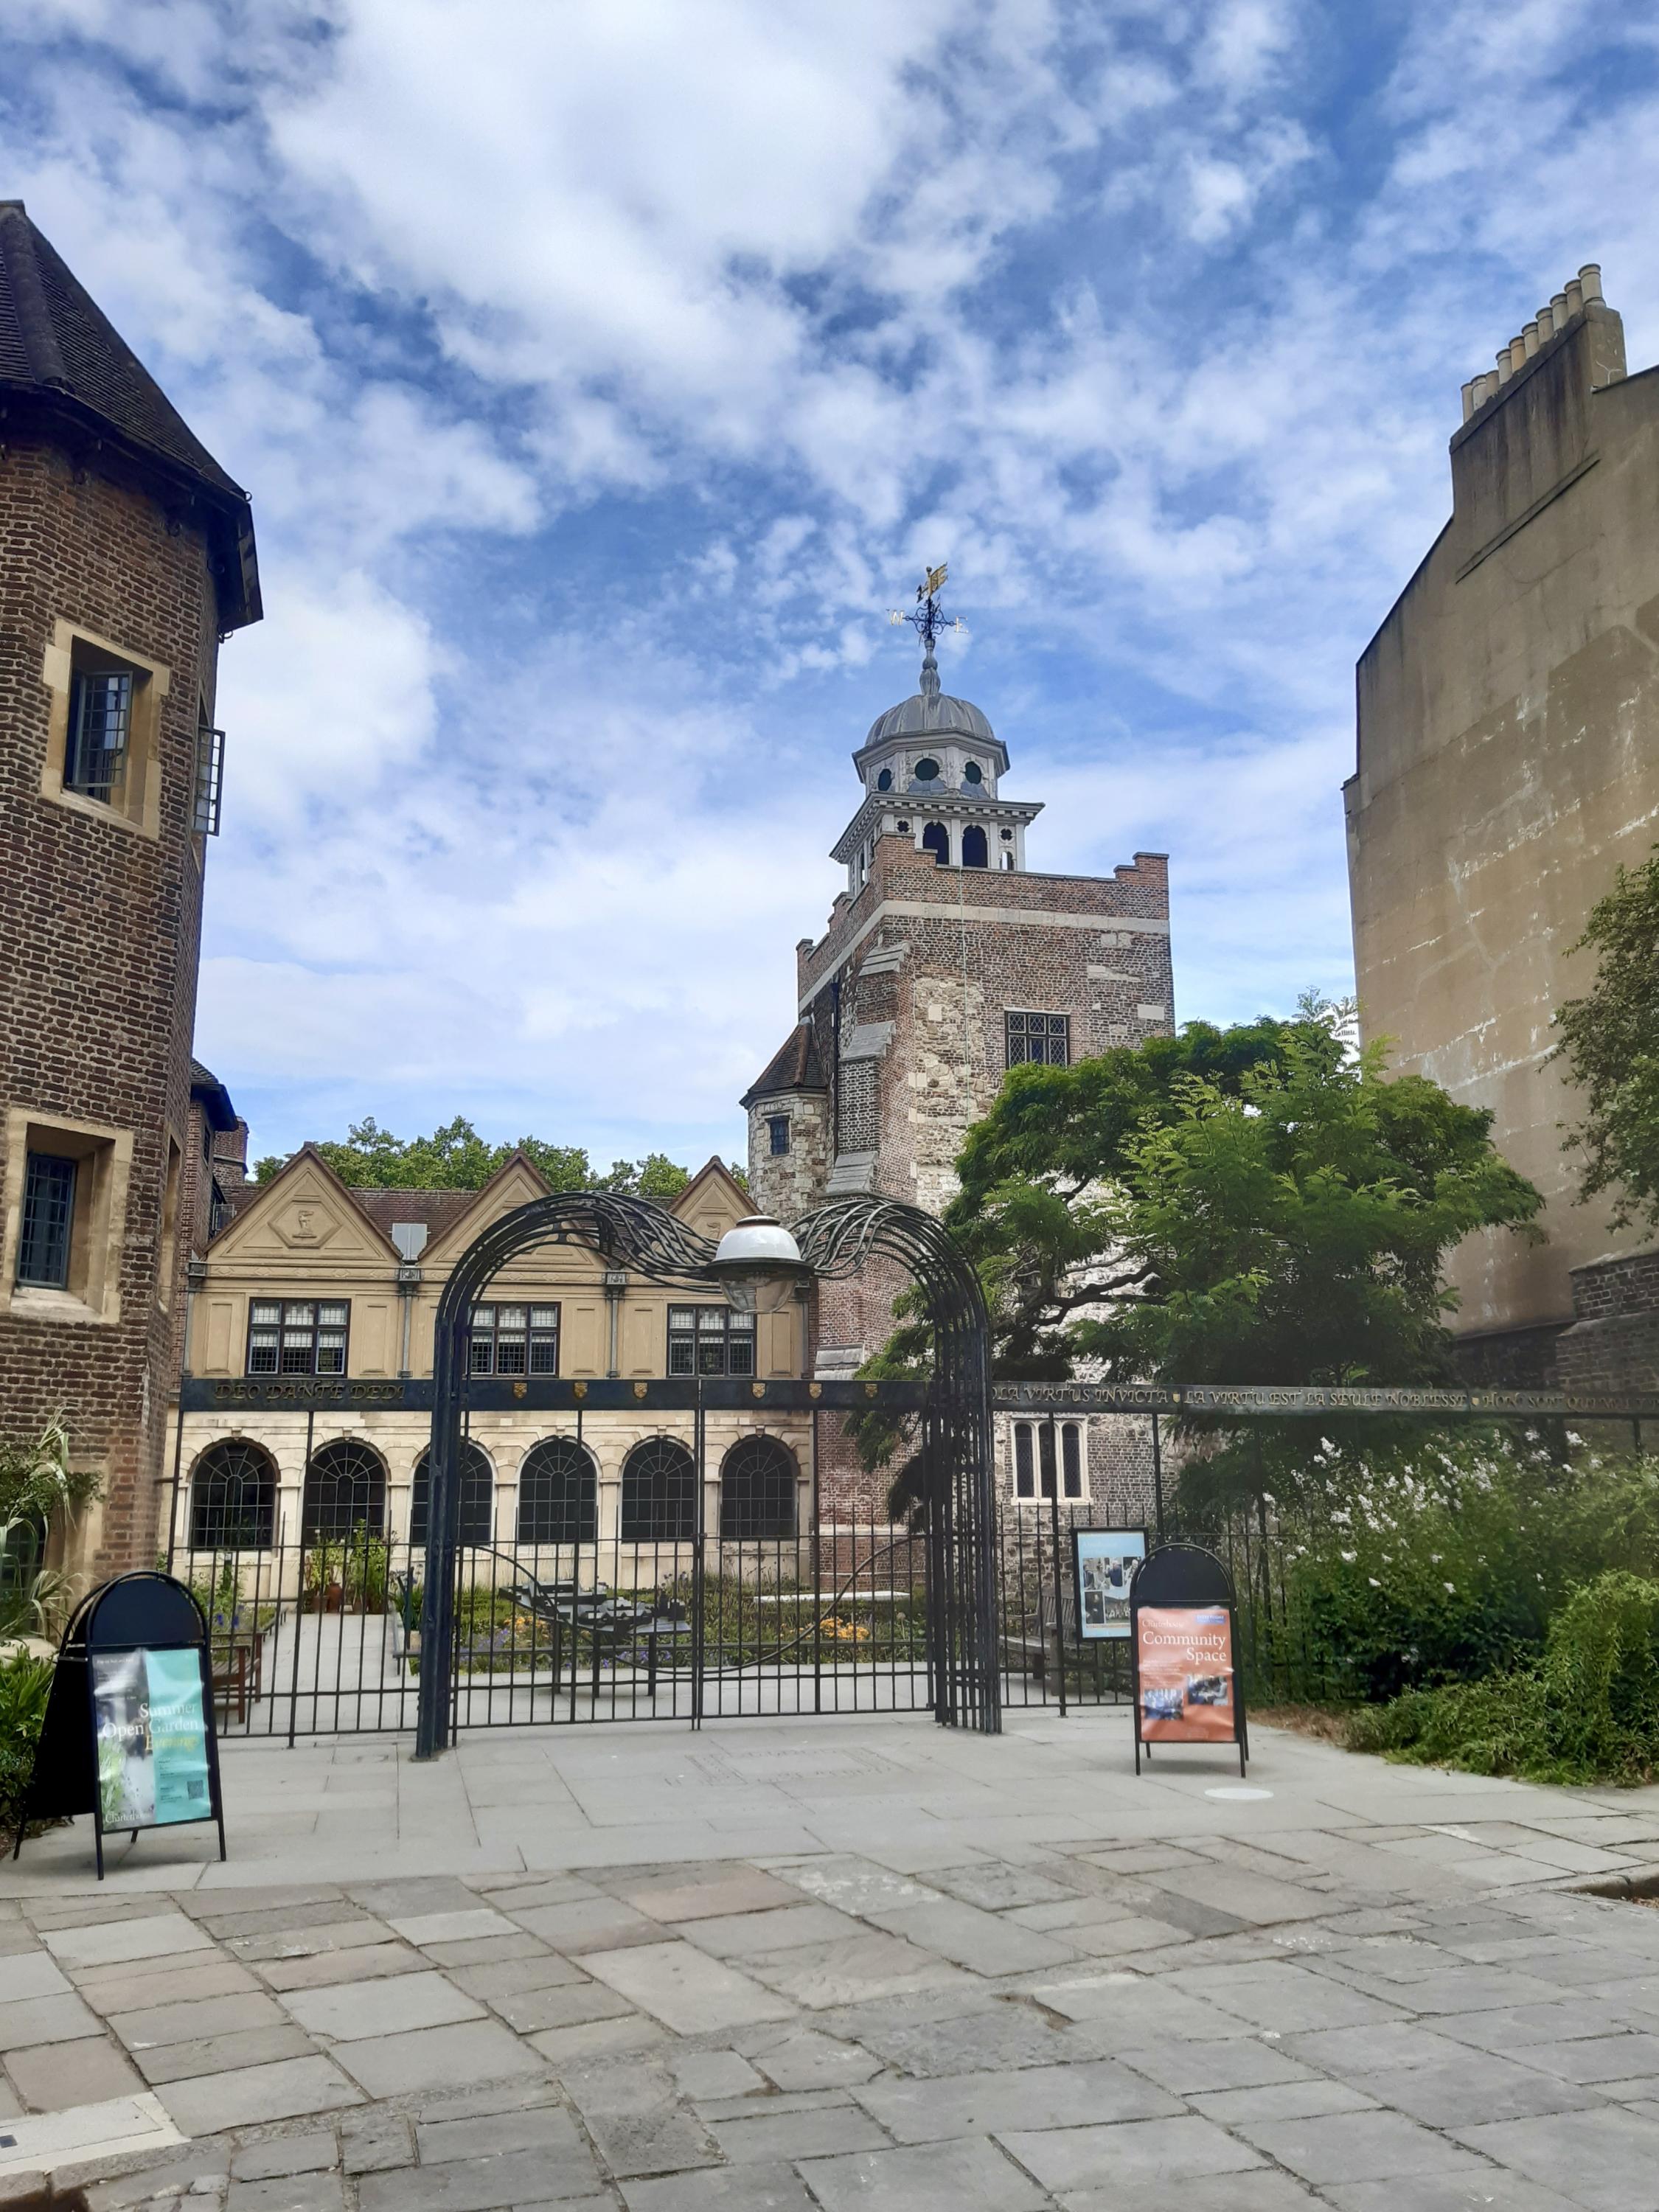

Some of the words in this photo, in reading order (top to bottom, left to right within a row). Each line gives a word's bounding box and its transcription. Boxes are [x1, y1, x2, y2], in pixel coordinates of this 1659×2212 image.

[886, 609, 905, 625] W
[954, 616, 969, 633] E
[214, 1384, 260, 1399] DEO
[265, 1381, 345, 1400] DANTE
[349, 1384, 406, 1400] DEDI
[1023, 1385, 1090, 1402] VIRTUS
[1093, 1385, 1168, 1403] INVICTA
[1183, 1391, 1206, 1405] LA
[1269, 1389, 1303, 1406] EST
[1304, 1394, 1326, 1406] LA
[1329, 1393, 1382, 1408] SEULE
[1385, 1391, 1467, 1408] NOBLESSE
[1142, 1630, 1226, 1650] Community
[1186, 1646, 1227, 1666] Space
[140, 1703, 198, 1719] Summer
[102, 1722, 144, 1742] Open
[149, 1715, 198, 1733] Garden
